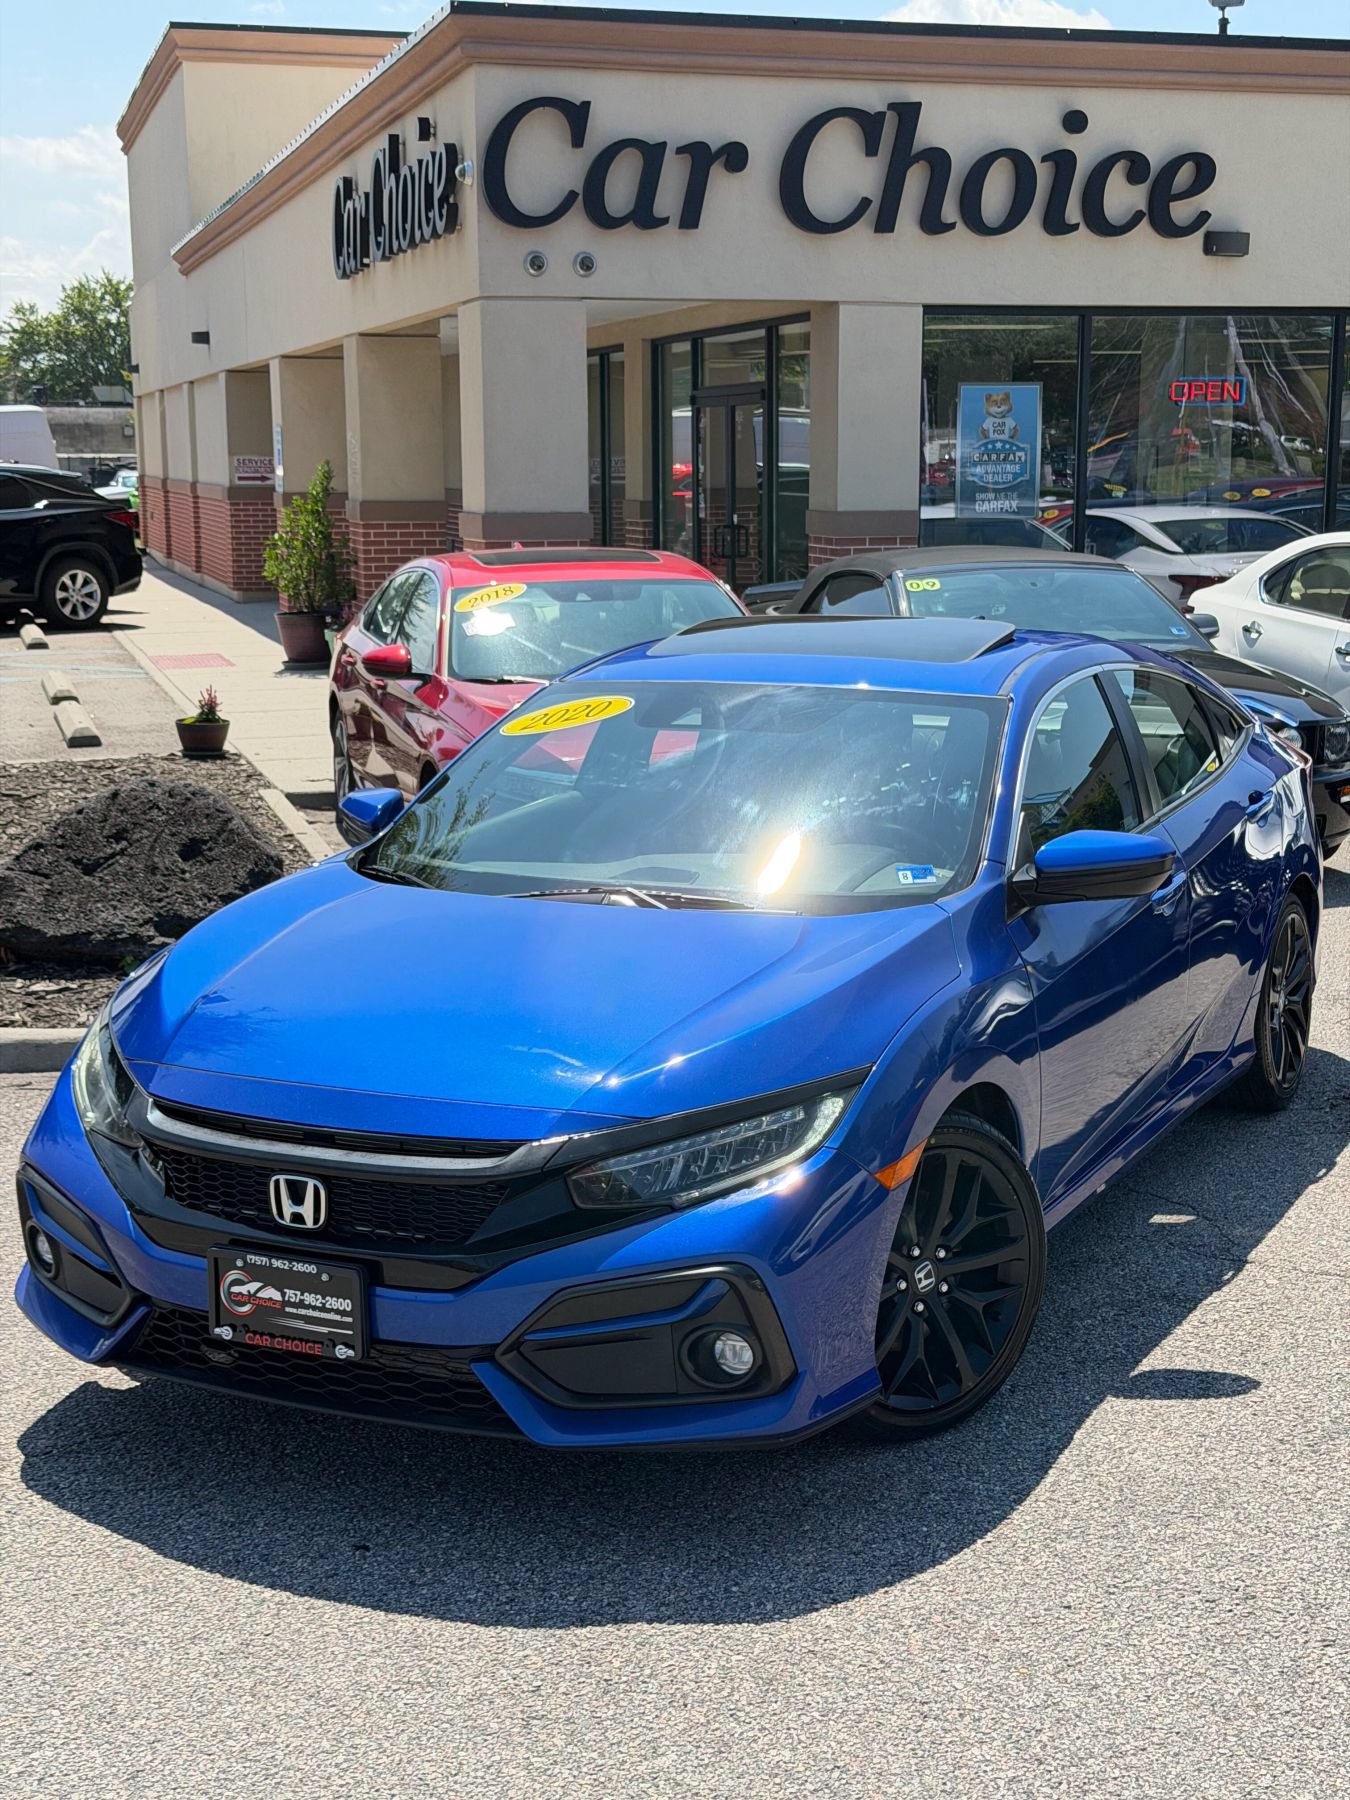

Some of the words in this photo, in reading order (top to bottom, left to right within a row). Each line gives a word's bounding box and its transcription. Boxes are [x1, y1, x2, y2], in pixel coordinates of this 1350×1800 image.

[482, 96, 748, 231] Car
[779, 101, 1217, 239] Choice
[332, 176, 370, 280] Car
[369, 117, 459, 262] Choice
[1169, 381, 1240, 401] OPEN
[992, 421, 1006, 429] CAR
[992, 428, 1006, 436] FOX
[236, 458, 274, 466] SERVICE
[973, 452, 1025, 463] CARFAX
[976, 463, 1021, 473] ADVANTAGE
[983, 473, 1013, 482] DEALER
[975, 492, 996, 500] SHOW
[1007, 492, 1019, 500] THE
[975, 500, 1019, 513] CARFAX
[909, 581, 937, 590] 09
[468, 586, 514, 608] 2018
[519, 700, 613, 731] 2020
[901, 872, 909, 881] 8
[247, 1255, 270, 1267] (757)
[271, 1258, 317, 1274] 962-2600
[231, 1293, 249, 1302] CAR
[251, 1297, 282, 1309] CHOICE
[283, 1288, 352, 1311] 757-962-2600
[245, 1332, 272, 1347] CAR
[274, 1337, 323, 1356] CHOICE
